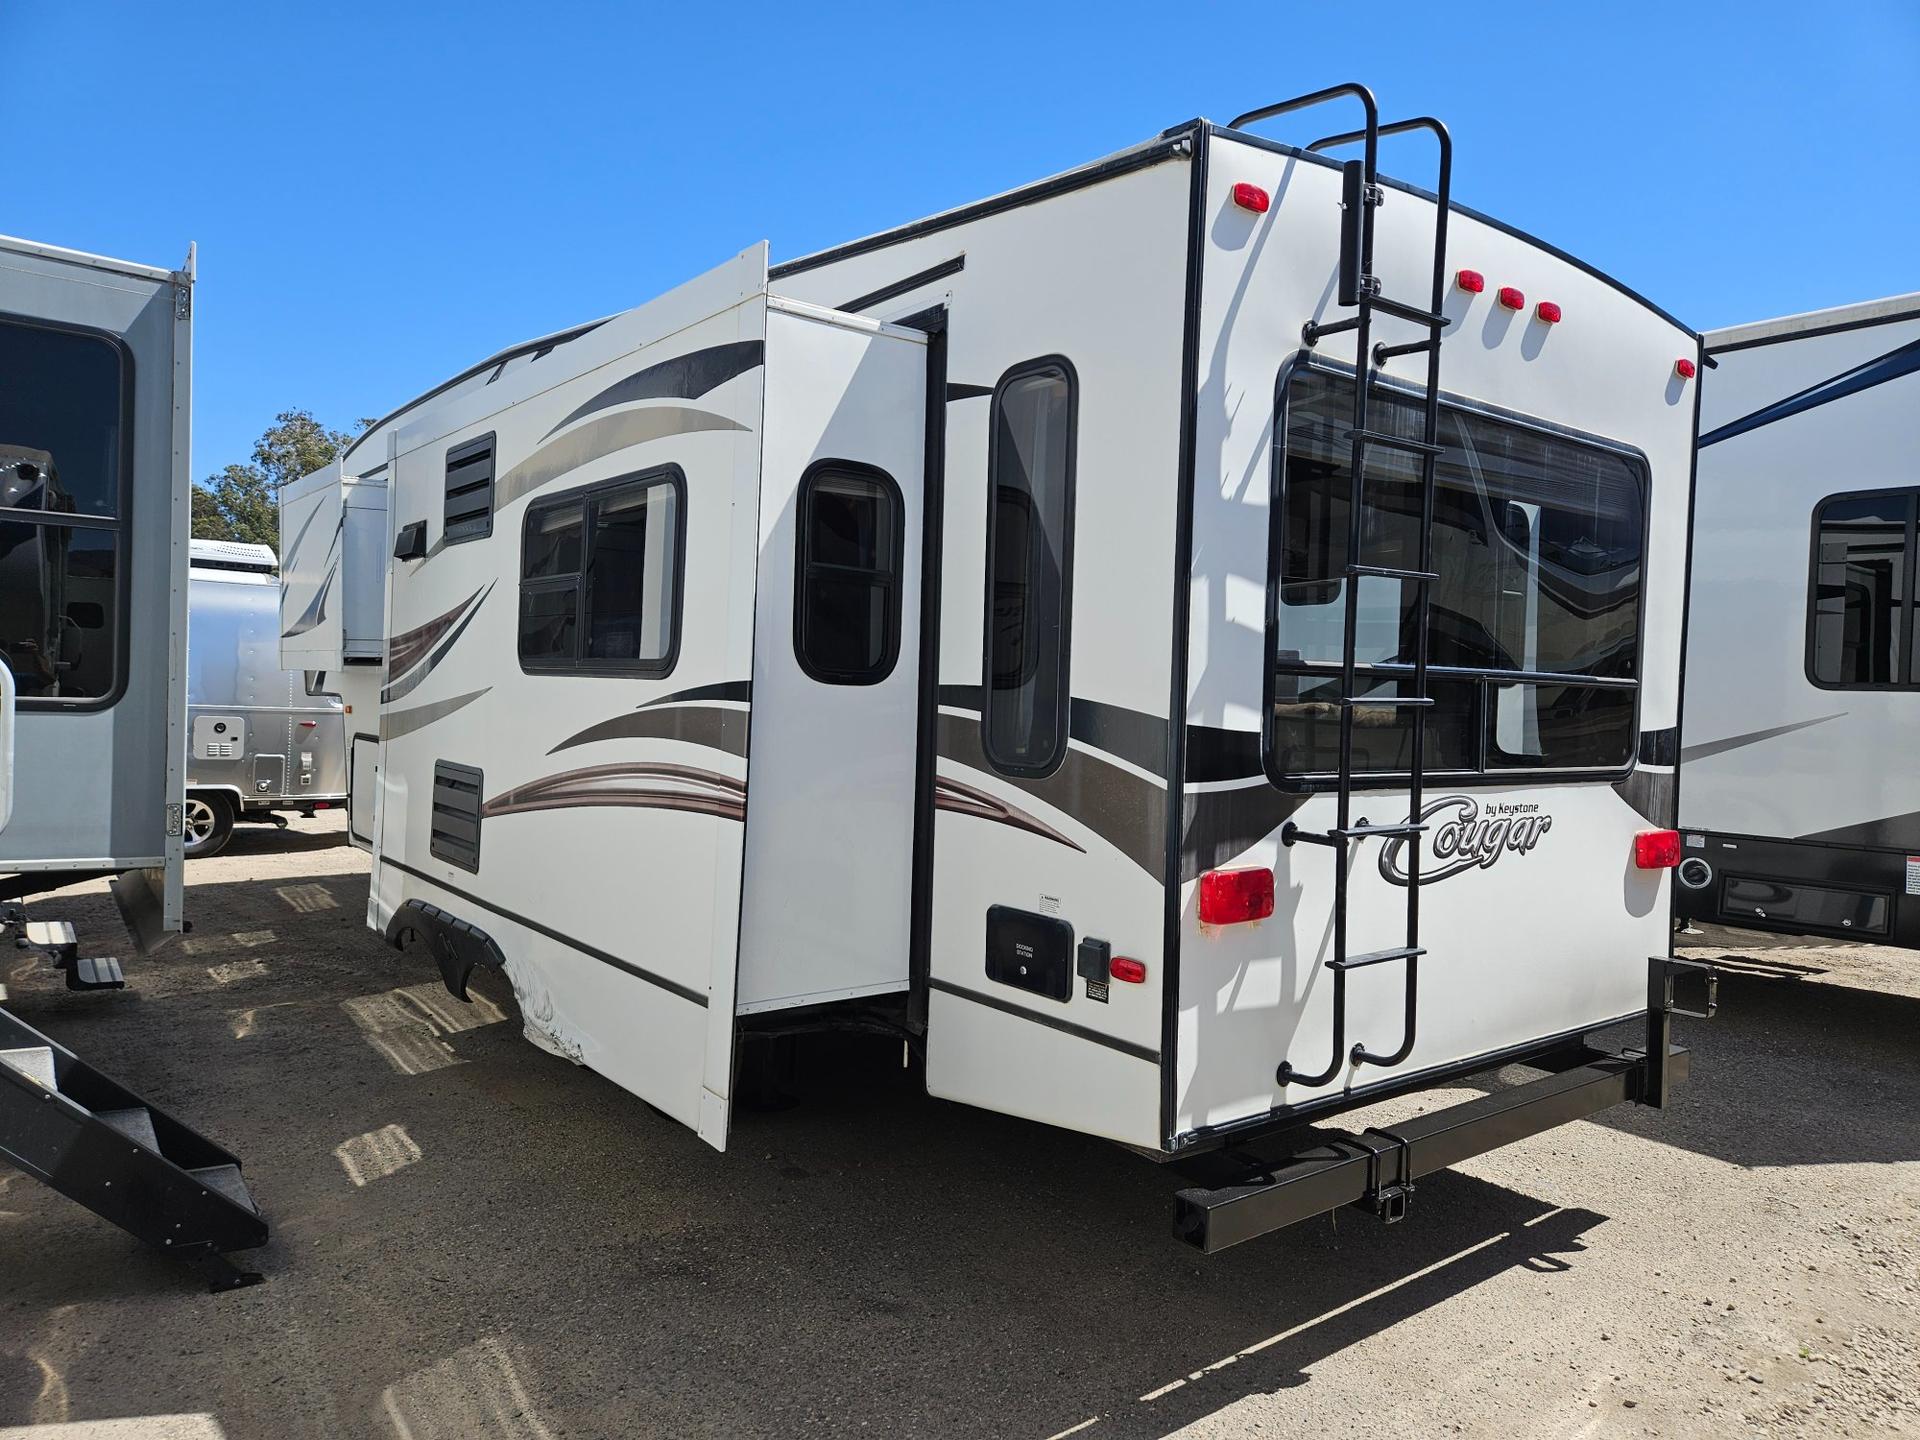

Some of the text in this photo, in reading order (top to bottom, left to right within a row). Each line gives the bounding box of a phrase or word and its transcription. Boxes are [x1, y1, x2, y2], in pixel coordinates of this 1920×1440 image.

[1485, 803, 1539, 817] by Keystone
[1378, 795, 1552, 886] Cougar
